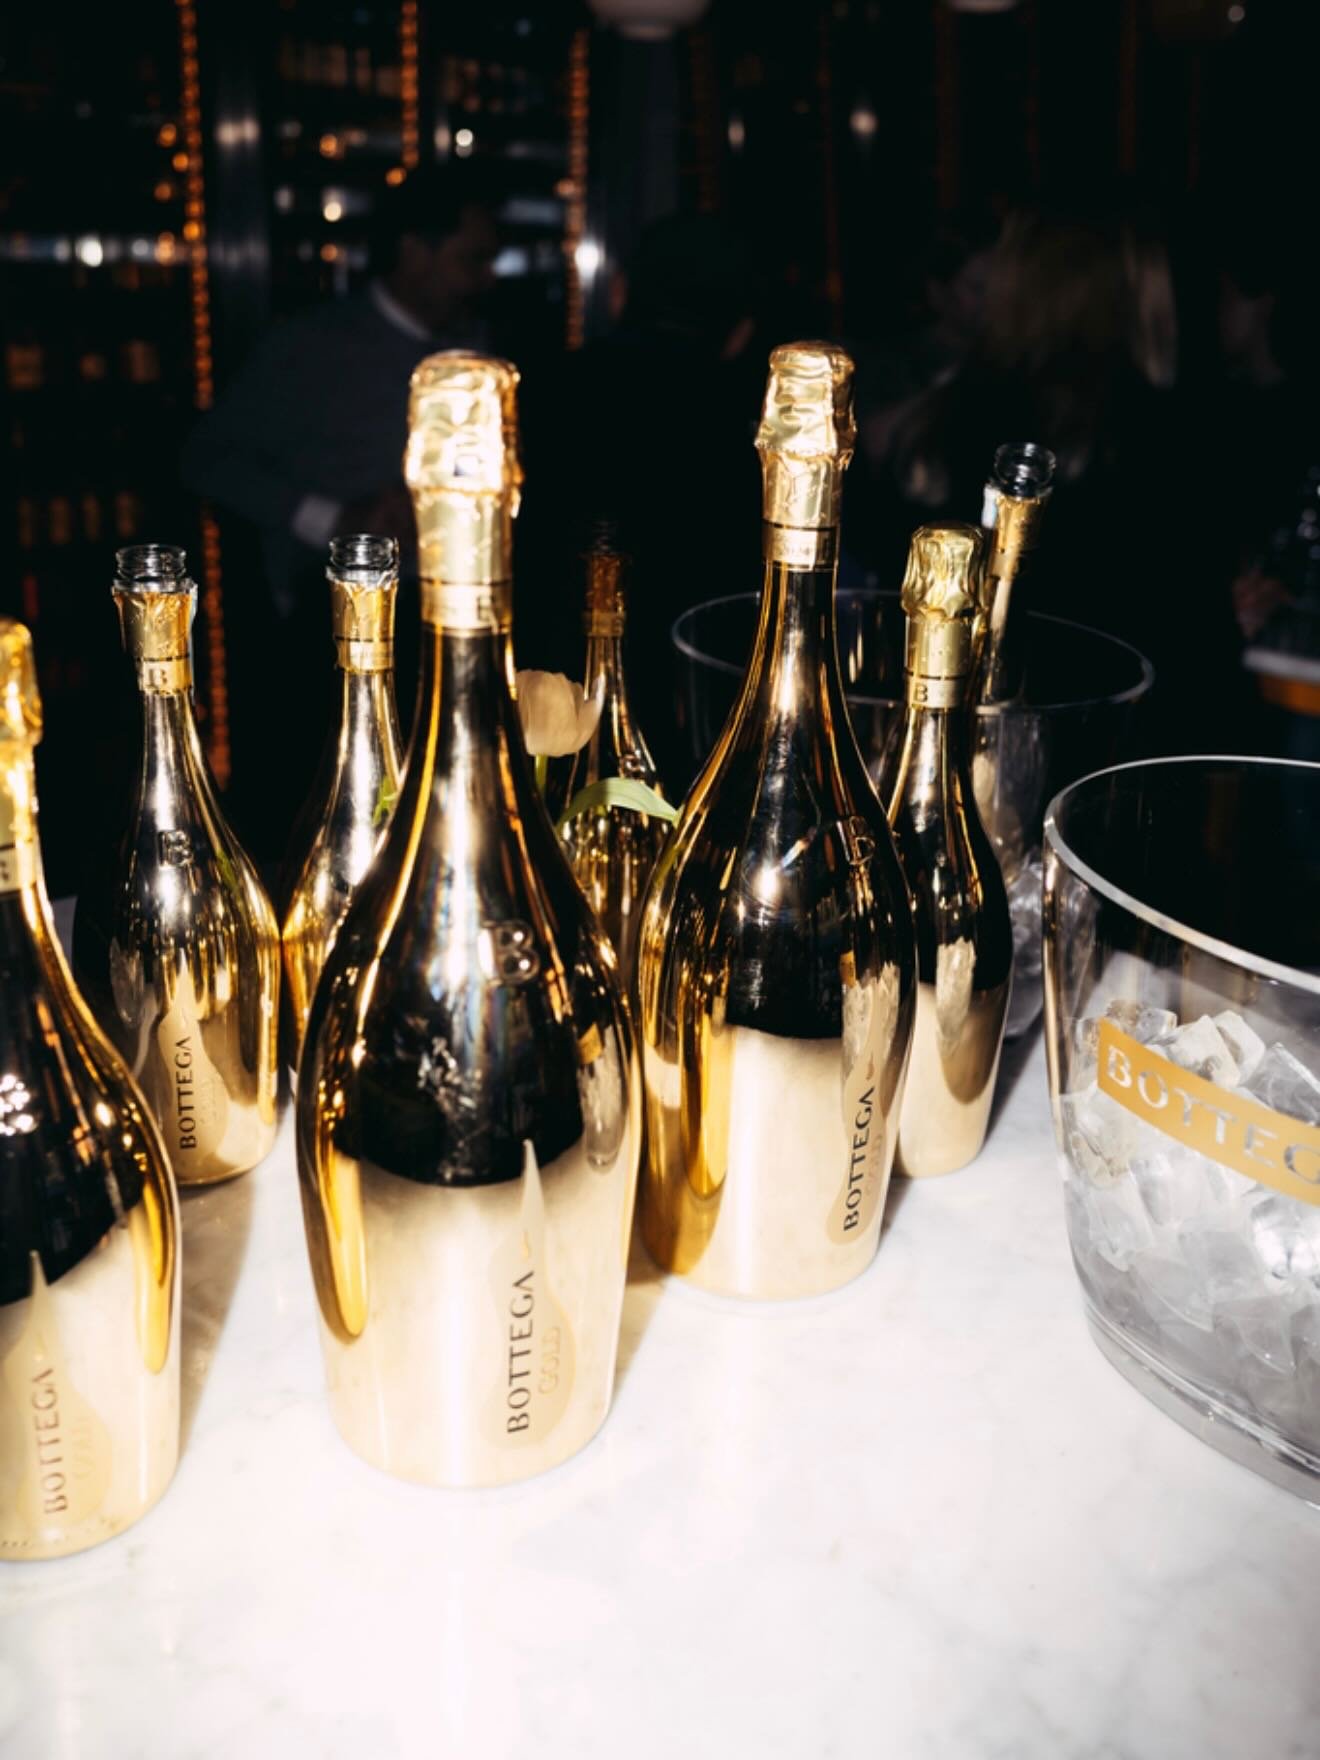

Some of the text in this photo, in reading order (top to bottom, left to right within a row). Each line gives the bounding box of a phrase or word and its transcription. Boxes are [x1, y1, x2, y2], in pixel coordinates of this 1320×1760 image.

[914, 682, 928, 702] B
[479, 919, 540, 984] B
[175, 1036, 197, 1149] BOTTEGA
[843, 1087, 875, 1231] BOTTEGA
[507, 1270, 535, 1433] BOTTEGA
[32, 1368, 68, 1515] BOTTEGA
